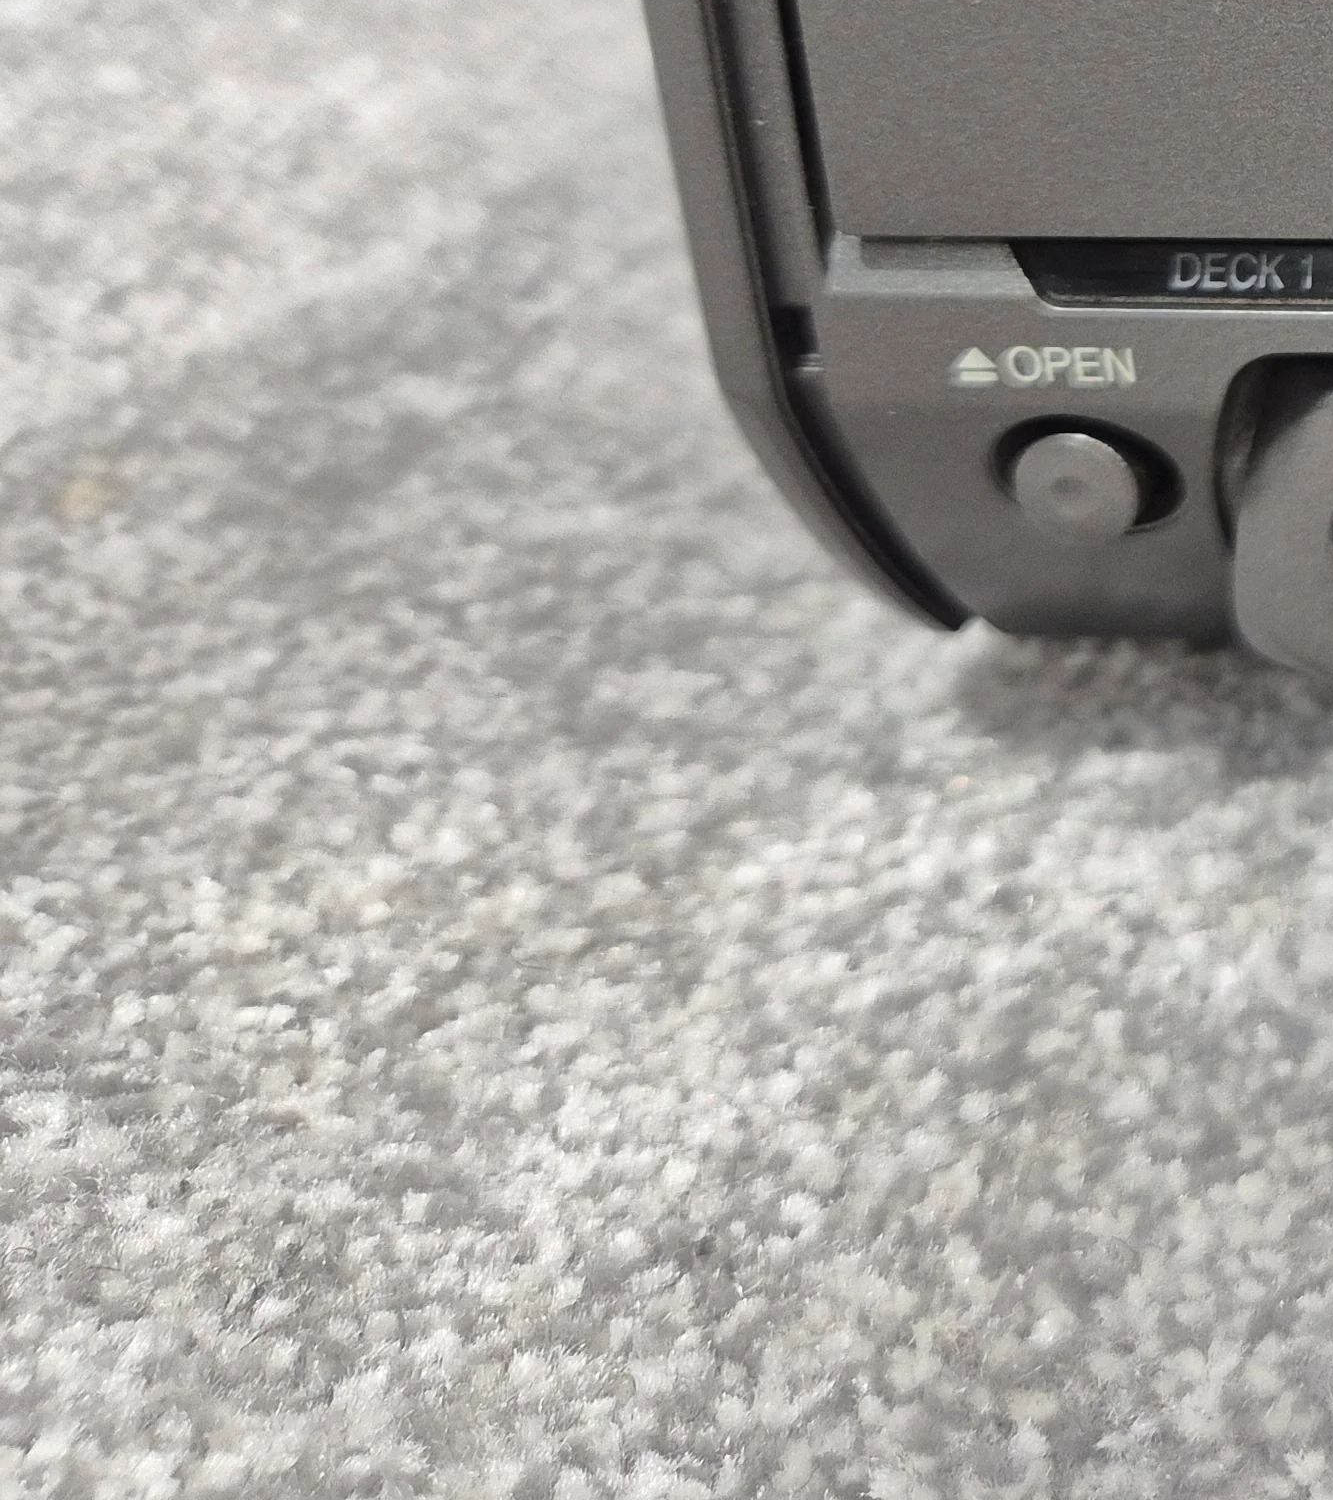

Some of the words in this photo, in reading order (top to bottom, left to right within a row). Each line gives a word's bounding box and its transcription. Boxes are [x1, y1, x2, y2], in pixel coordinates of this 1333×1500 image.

[1169, 253, 1287, 290] DECK
[1299, 253, 1315, 289] 1
[1003, 346, 1136, 386] OPEN
